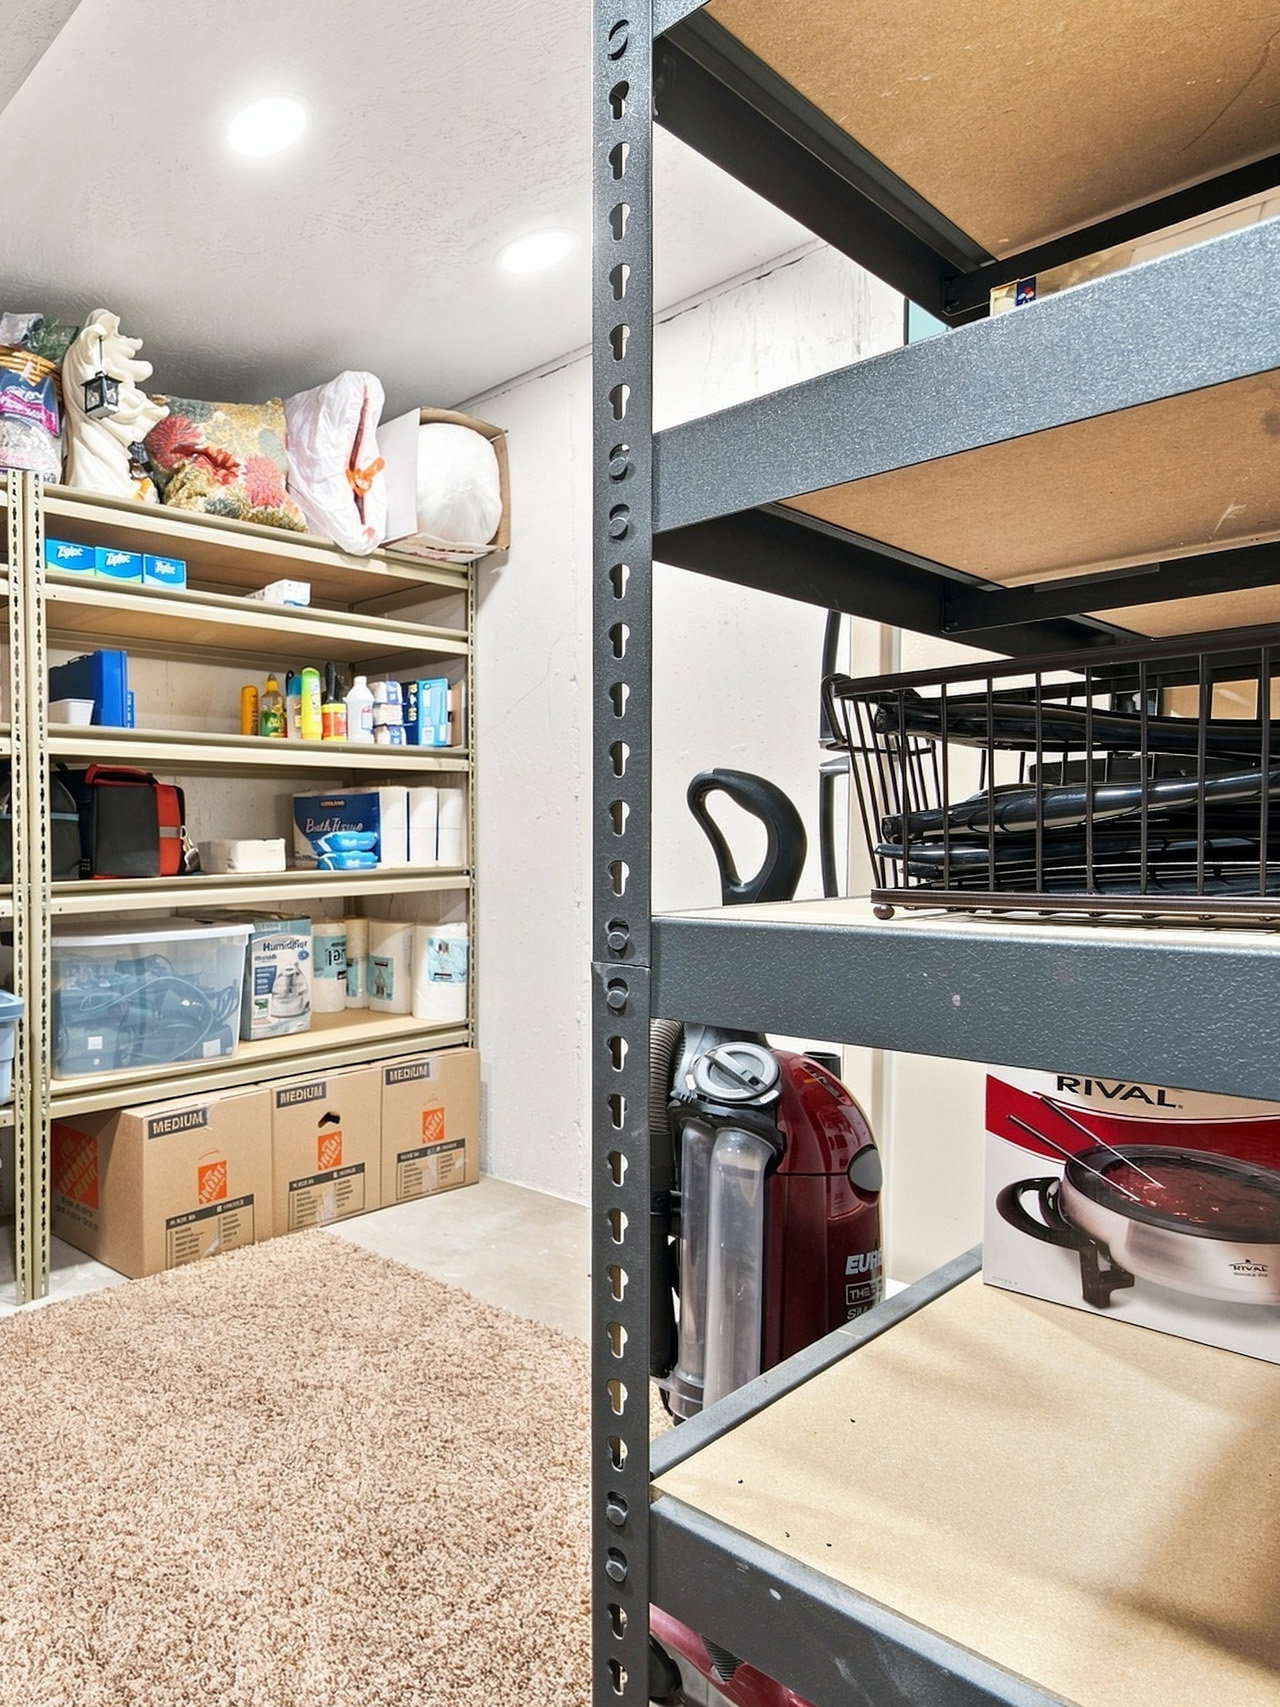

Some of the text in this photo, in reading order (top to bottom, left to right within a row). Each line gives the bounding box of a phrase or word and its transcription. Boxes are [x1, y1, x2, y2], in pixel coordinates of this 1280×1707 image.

[57, 545, 84, 560] Ziploc
[105, 552, 131, 567] Ziploc
[305, 816, 363, 834] Bath Tissue
[262, 939, 308, 952] Humidifier
[389, 1065, 428, 1081] MEDIUM
[280, 1086, 322, 1104] MEDIUM
[1056, 1075, 1176, 1108] RIVAL
[152, 1111, 203, 1134] MEDIUM
[849, 1286, 871, 1300] THE
